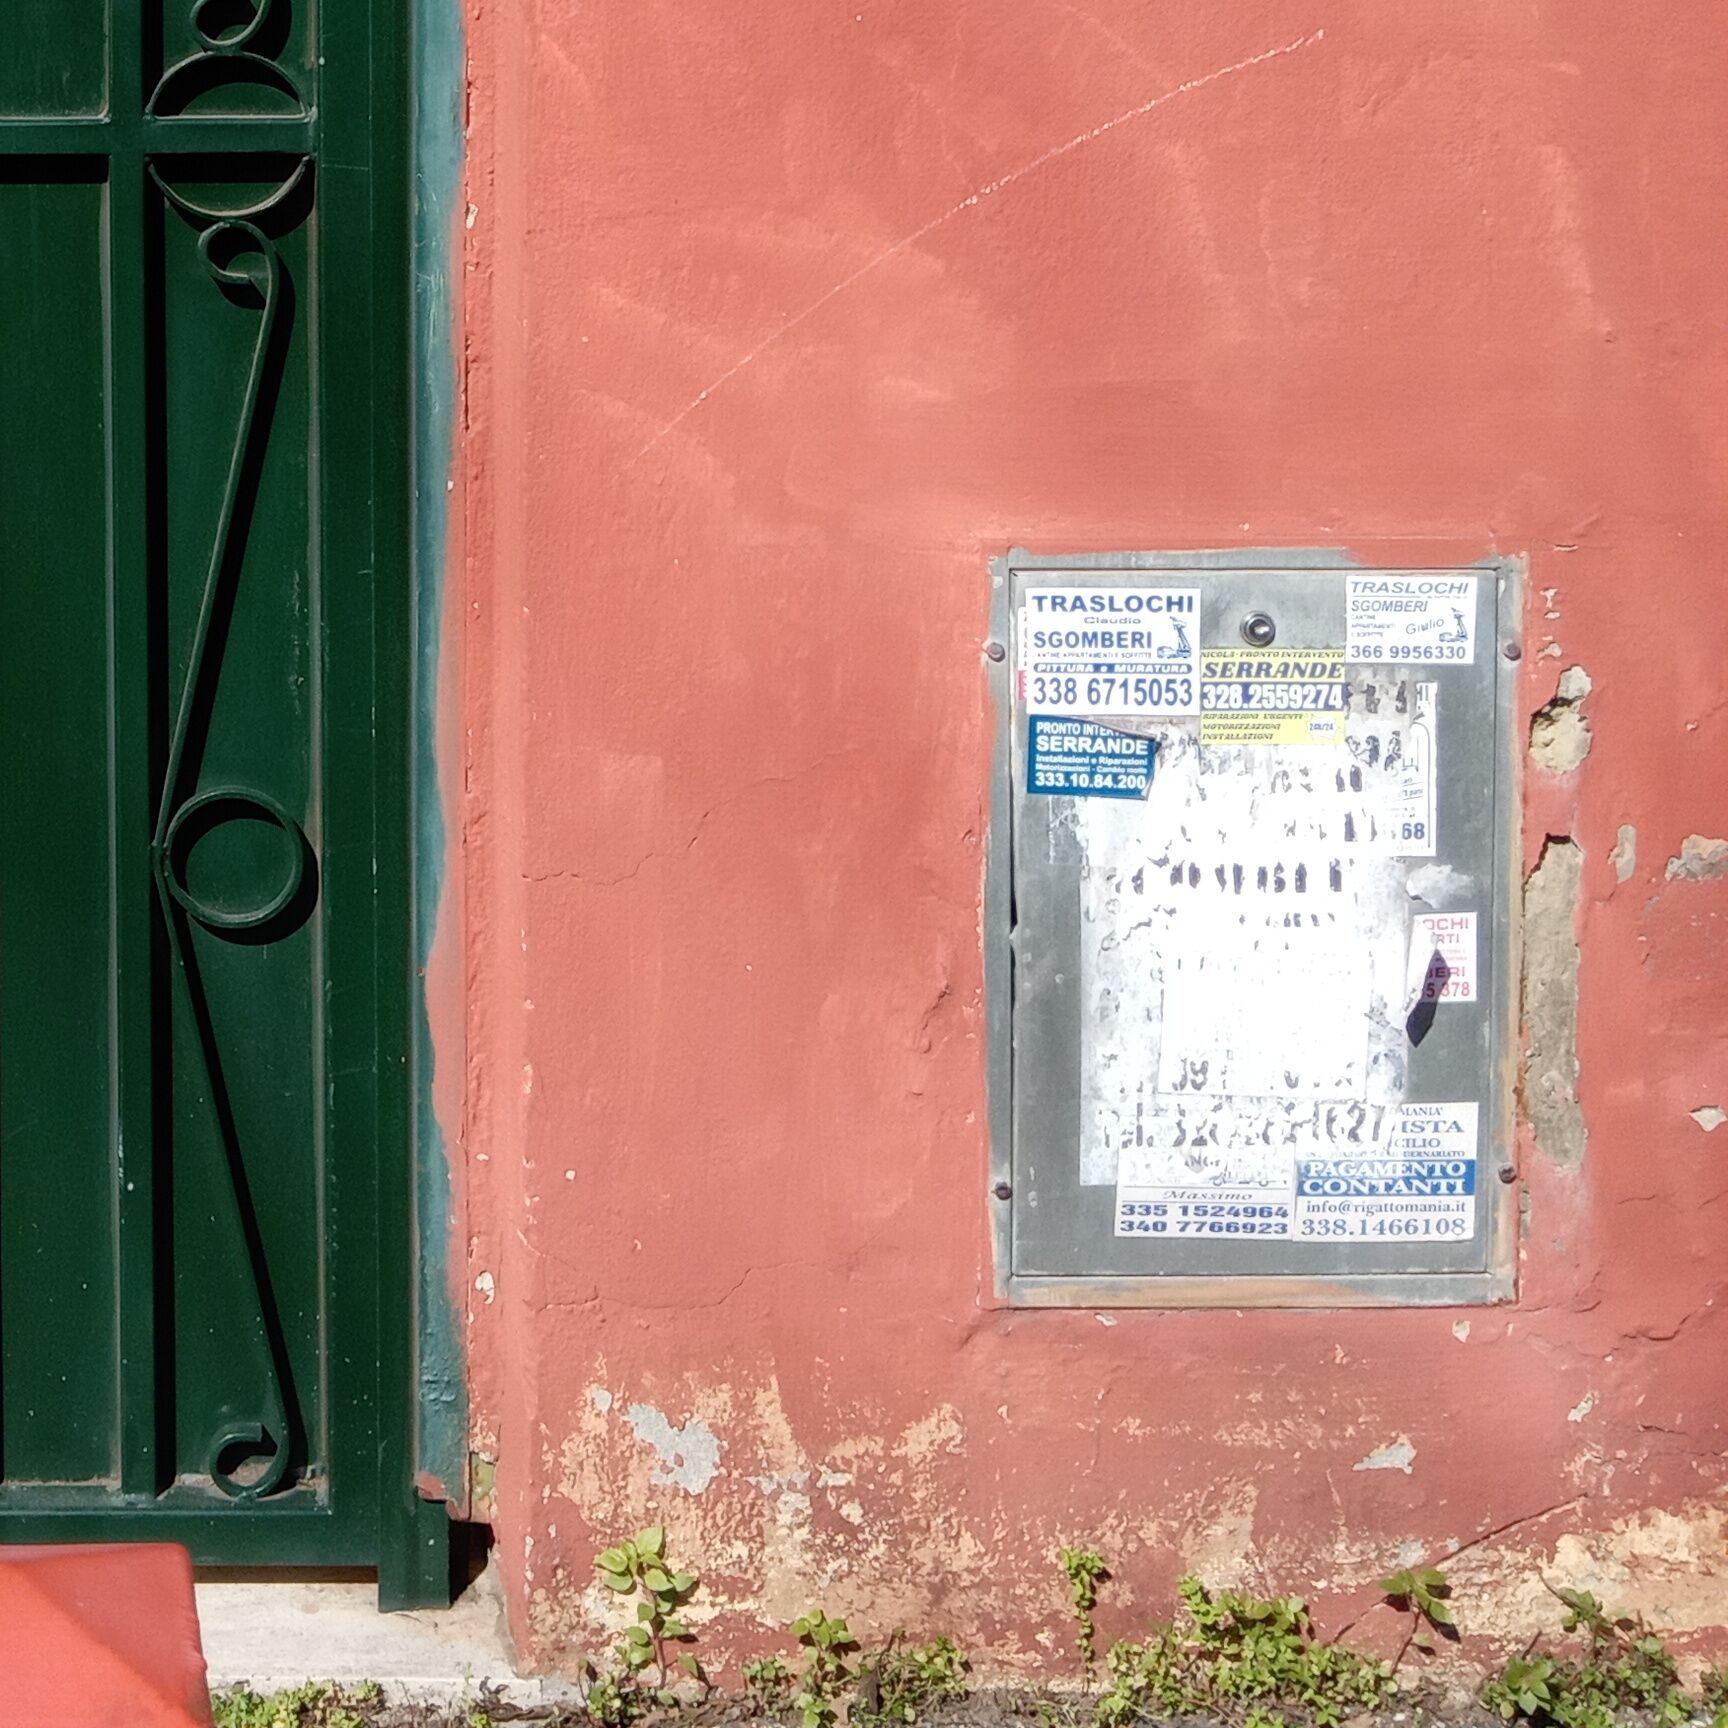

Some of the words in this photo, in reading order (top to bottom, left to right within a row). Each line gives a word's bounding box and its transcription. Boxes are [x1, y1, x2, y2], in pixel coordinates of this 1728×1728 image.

[1351, 581, 1469, 594] TRASLOCHI
[1032, 595, 1194, 613] TRASLOCHI
[1351, 600, 1429, 613] SGOMBERI
[1084, 616, 1142, 624] Claudio
[1033, 631, 1152, 649] SGOMBERI
[1351, 645, 1383, 658] 366
[1389, 646, 1466, 659] 9956330
[1037, 663, 1095, 673] PITTURA
[1113, 663, 1188, 673] MURATURA
[1202, 661, 1345, 679] SERRANDE
[1033, 677, 1078, 705] 338
[1087, 677, 1193, 707] 6715053
[1202, 684, 1343, 709] 328.2559274
[1036, 722, 1081, 735] PRONTO
[1036, 736, 1149, 755] SERRANDE
[1036, 754, 1089, 764] Installazioni
[1098, 756, 1148, 765] Riparazioni
[1035, 771, 1146, 789] 333.10.84.200
[1429, 966, 1465, 978] ERI
[1307, 1160, 1467, 1178] PAGAMENTO
[1303, 1178, 1466, 1195] CONTANTI
[1163, 1190, 1253, 1201] Massimo
[1120, 1204, 1168, 1216] 335
[1178, 1205, 1289, 1218] 1524964
[1306, 1200, 1466, 1216] info@rigattomania.it
[1120, 1220, 1168, 1232] 340
[1176, 1221, 1289, 1234] 7766923
[1301, 1218, 1466, 1236] 338.1466108
